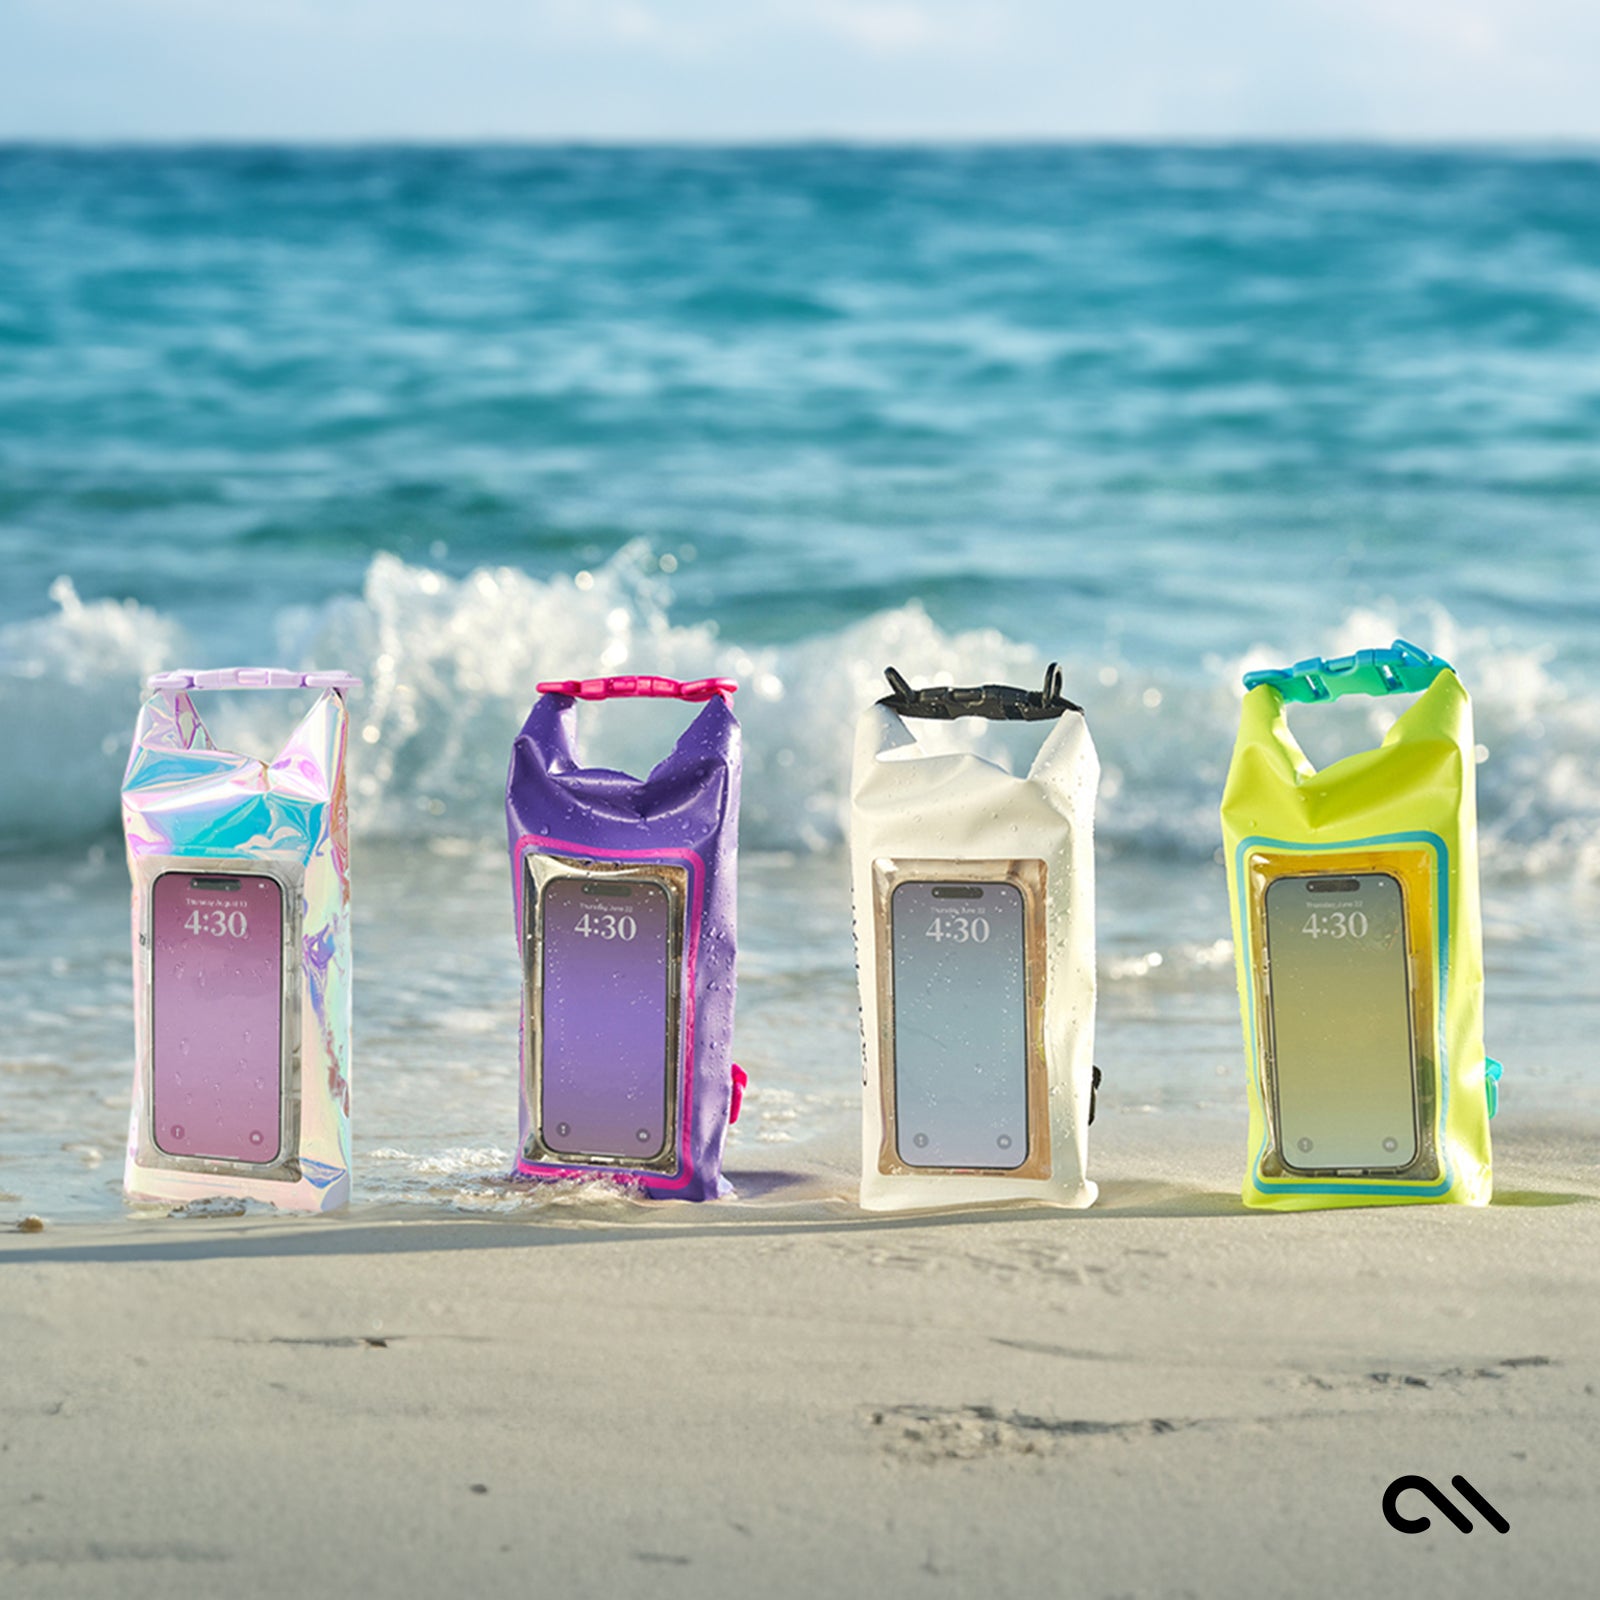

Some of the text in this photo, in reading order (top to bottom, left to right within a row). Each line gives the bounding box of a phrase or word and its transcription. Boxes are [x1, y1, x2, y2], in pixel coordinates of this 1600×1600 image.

[184, 910, 248, 938] 4:30
[574, 913, 637, 941] 4:30
[925, 917, 990, 943] 4:30
[1302, 911, 1369, 939] 4:30
